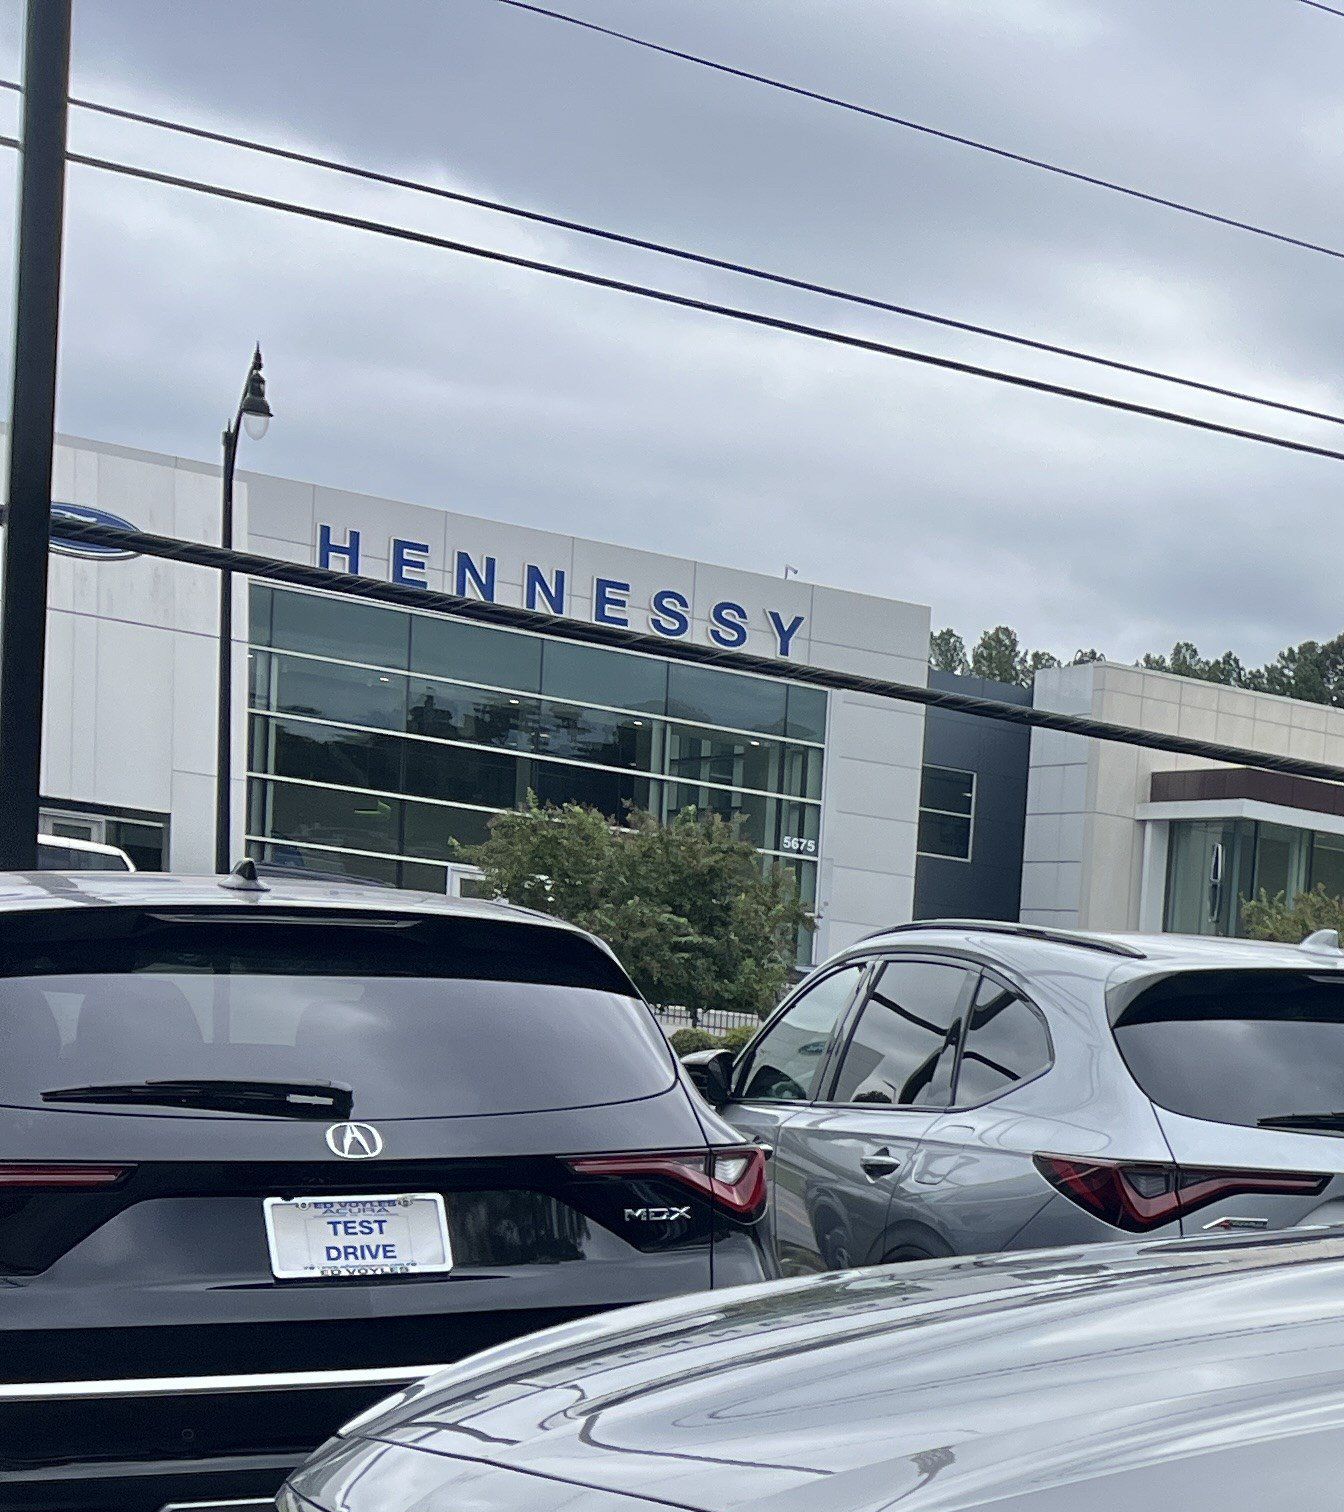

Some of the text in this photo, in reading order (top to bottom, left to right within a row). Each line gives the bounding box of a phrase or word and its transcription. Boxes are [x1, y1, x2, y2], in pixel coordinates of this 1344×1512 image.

[317, 524, 805, 657] HENNESSY
[783, 836, 816, 852] 5675
[623, 1206, 692, 1222] MDX
[327, 1219, 388, 1237] TEST
[325, 1244, 397, 1261] DRIVE
